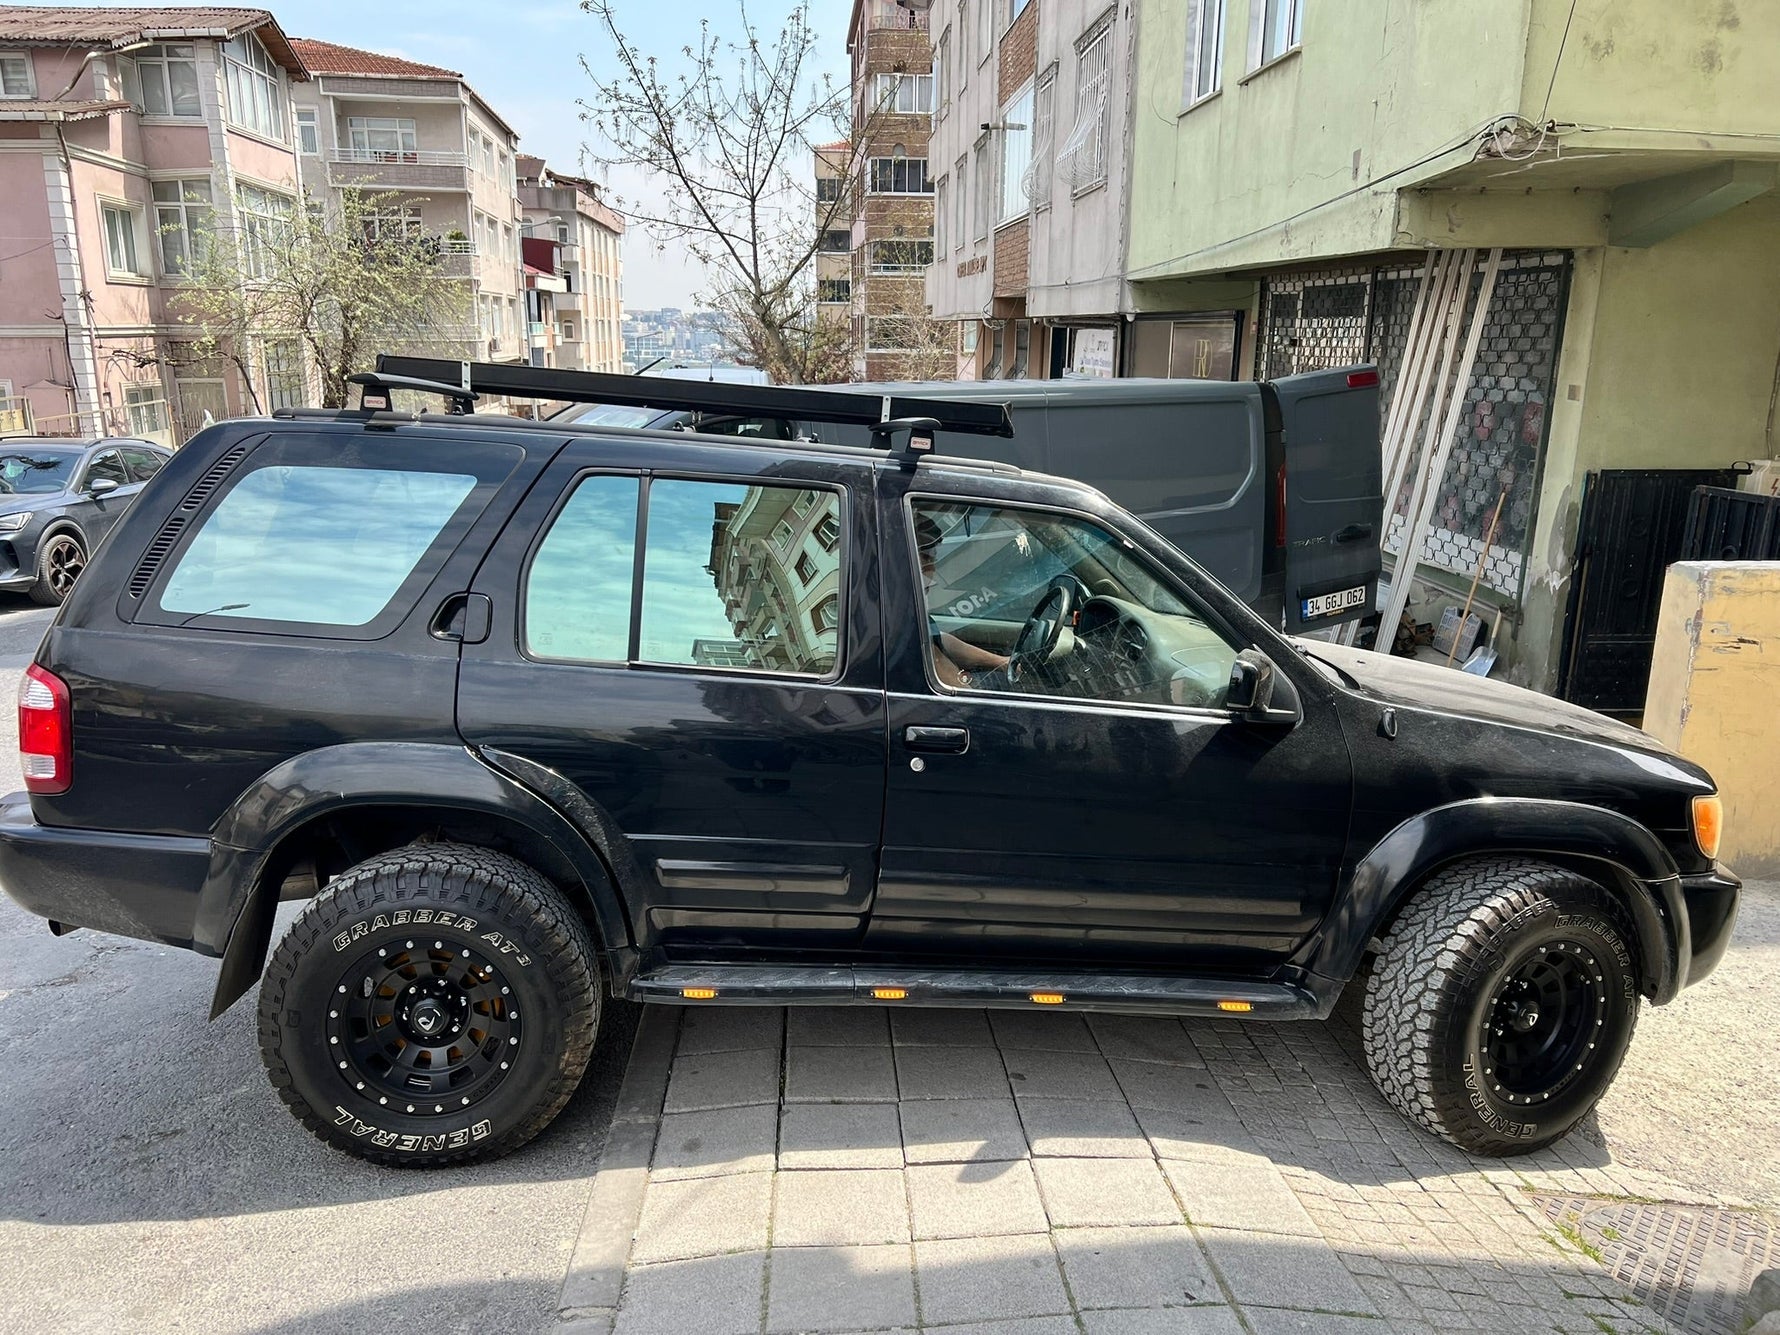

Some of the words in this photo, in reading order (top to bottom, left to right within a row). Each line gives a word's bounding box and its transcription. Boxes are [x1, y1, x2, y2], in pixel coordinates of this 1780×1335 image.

[1309, 599, 1320, 614] 34
[1325, 594, 1343, 610] GGJ
[1347, 588, 1364, 605] 062
[333, 909, 478, 952] GRABBER
[1554, 914, 1631, 967] GRABBER
[1463, 1053, 1538, 1138] GENERAL
[334, 1105, 492, 1152] GENERAL
